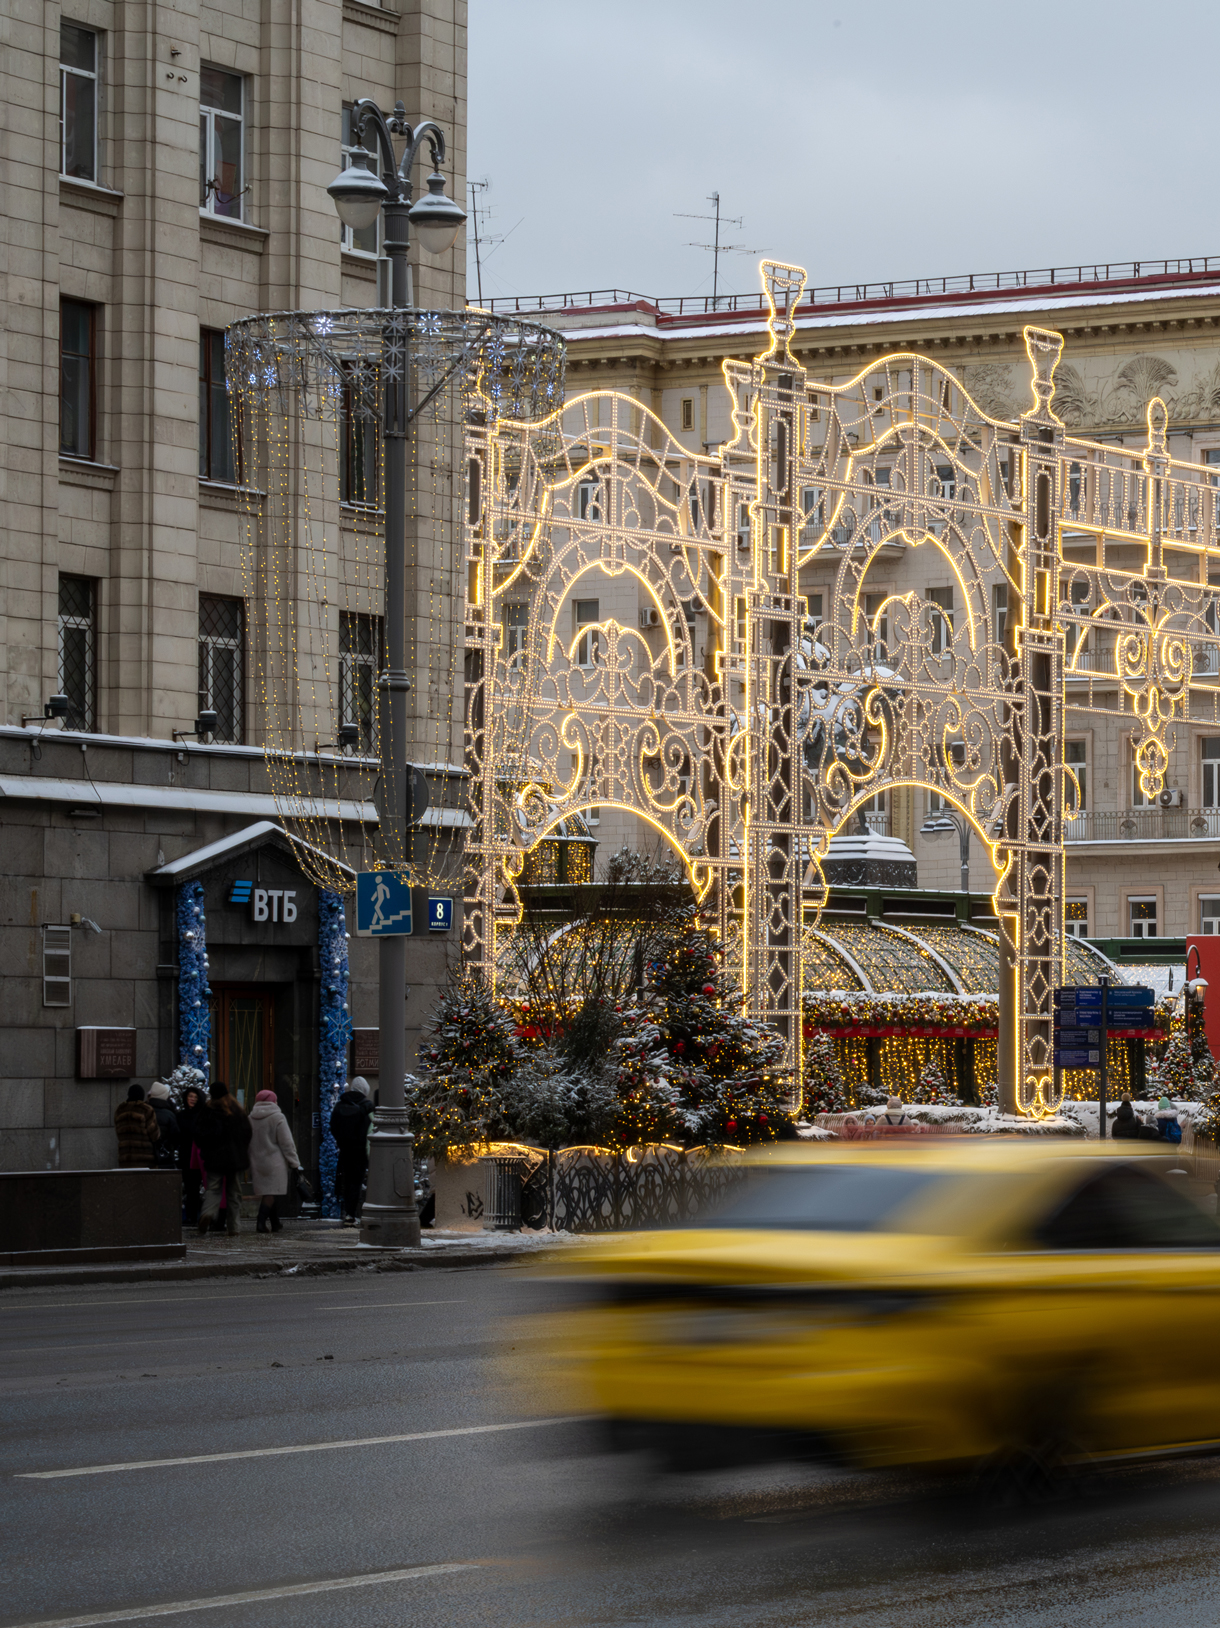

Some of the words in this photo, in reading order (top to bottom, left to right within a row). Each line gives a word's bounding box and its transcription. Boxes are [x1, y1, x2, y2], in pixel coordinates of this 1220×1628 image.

[252, 888, 298, 923] ВТБ
[436, 902, 444, 920] 8
[100, 1055, 132, 1066] ХМЕЛЕВ
[356, 1058, 379, 1068] РОТМИ
